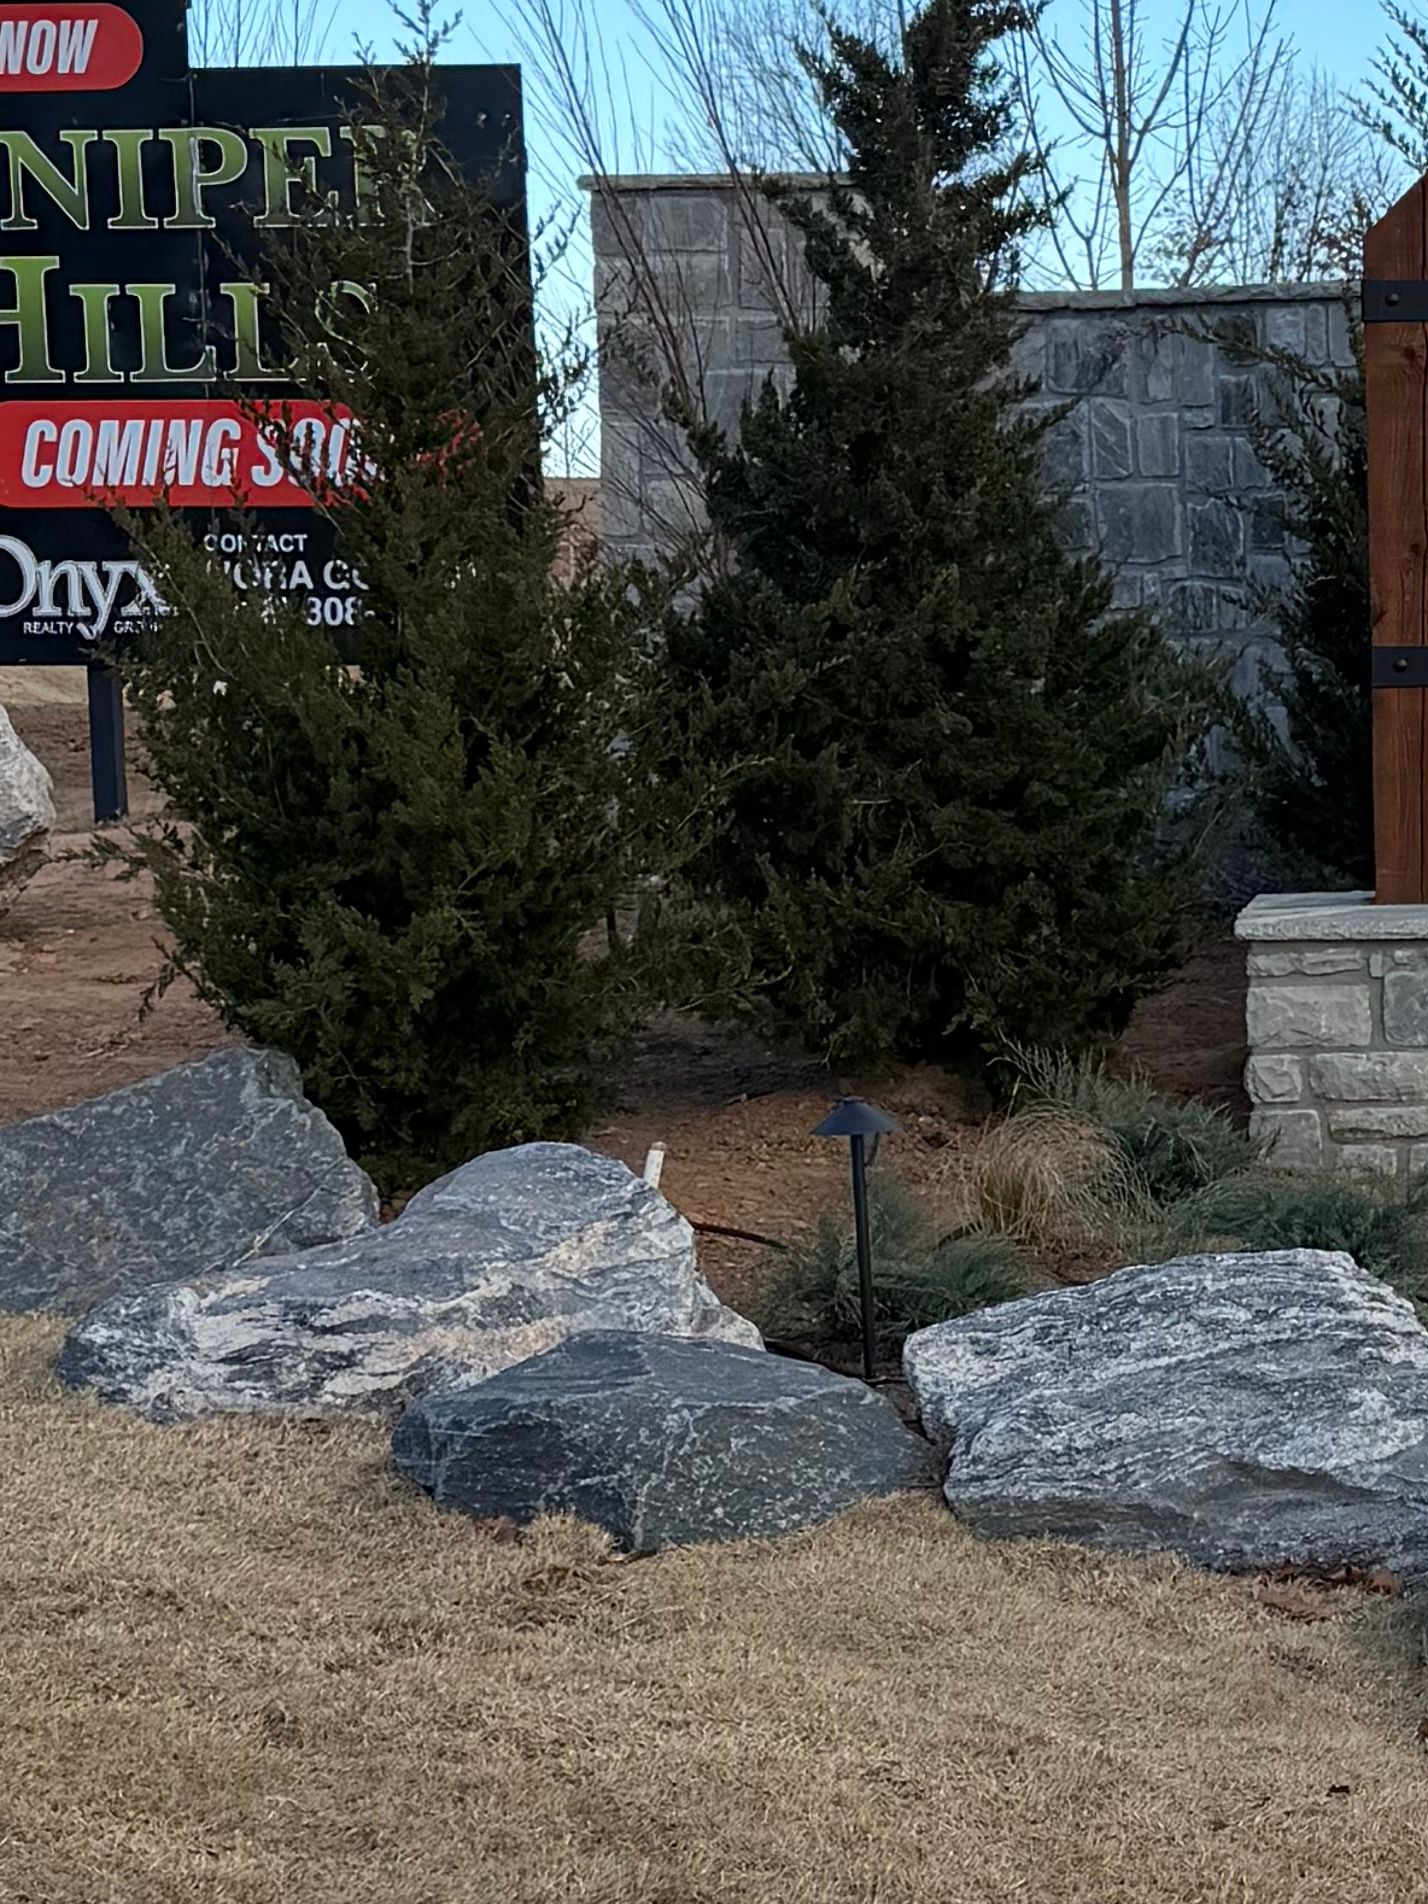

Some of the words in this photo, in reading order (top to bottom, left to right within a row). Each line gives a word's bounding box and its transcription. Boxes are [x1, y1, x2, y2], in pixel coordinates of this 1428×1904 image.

[0, 19, 98, 75] NOW
[21, 419, 242, 488] COMING
[23, 621, 74, 634] REALTY
